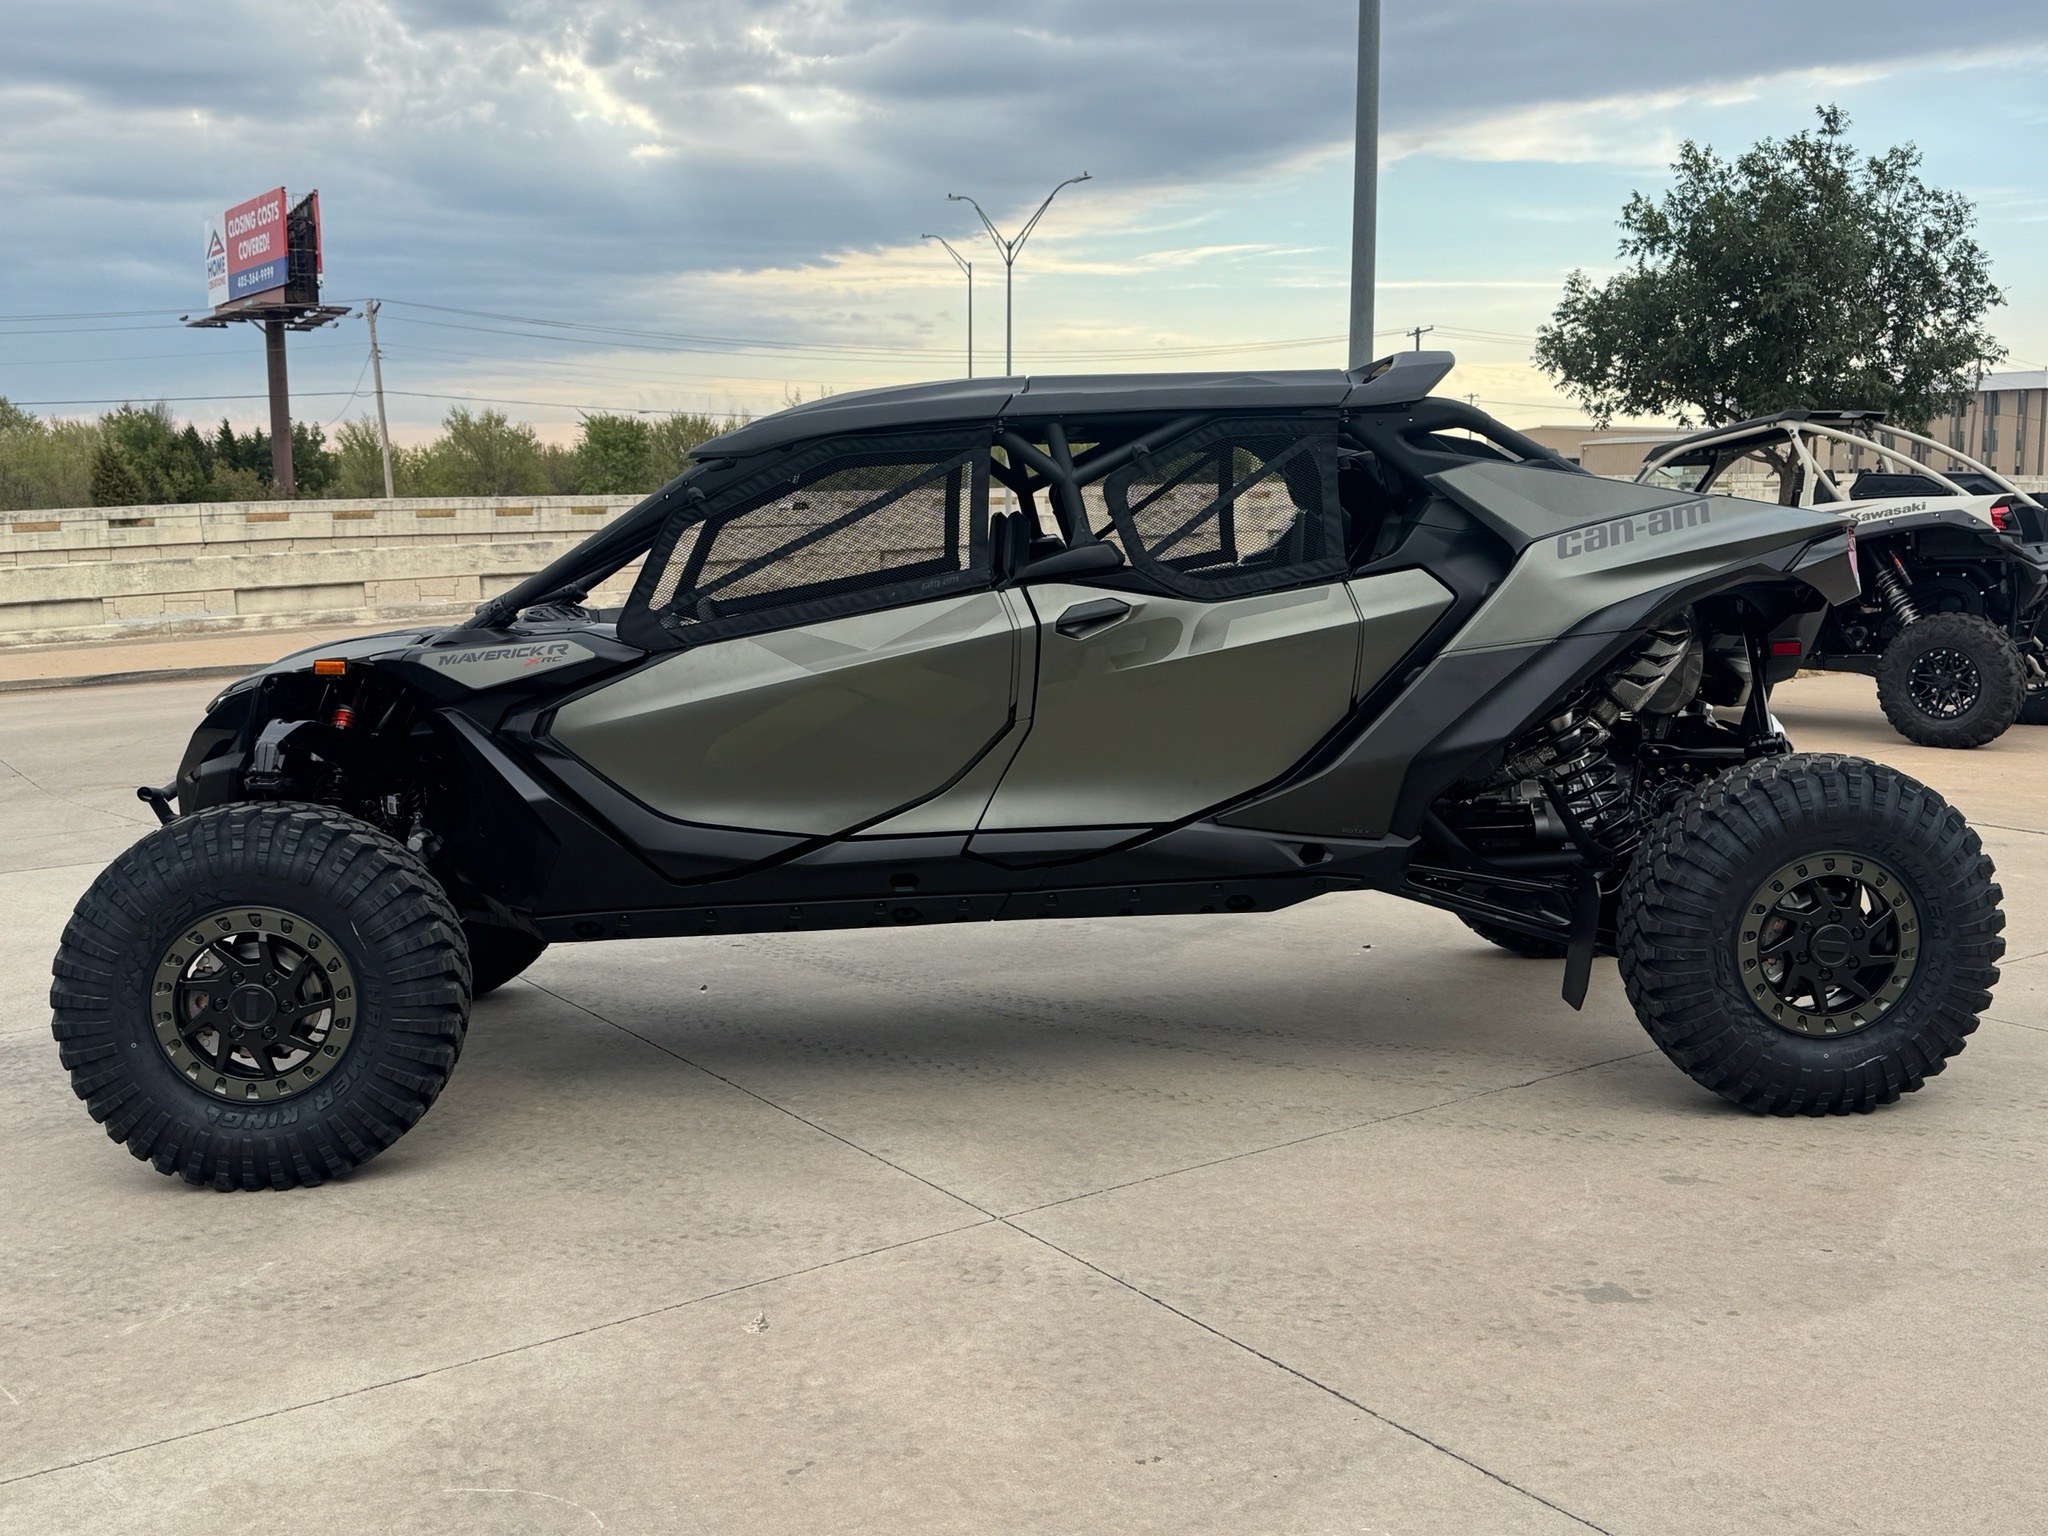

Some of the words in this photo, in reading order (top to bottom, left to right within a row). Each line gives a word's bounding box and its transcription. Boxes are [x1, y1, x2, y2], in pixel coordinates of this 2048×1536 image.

[228, 211, 256, 238] CLOSING
[257, 201, 279, 227] COSTS
[238, 232, 270, 260] COVERED!
[207, 256, 226, 279] HOME
[1850, 501, 1927, 523] Kawasaki
[1557, 501, 1711, 560] can-am
[438, 645, 546, 667] MAVERICK
[547, 643, 569, 656] R
[219, 1105, 300, 1131] KING
